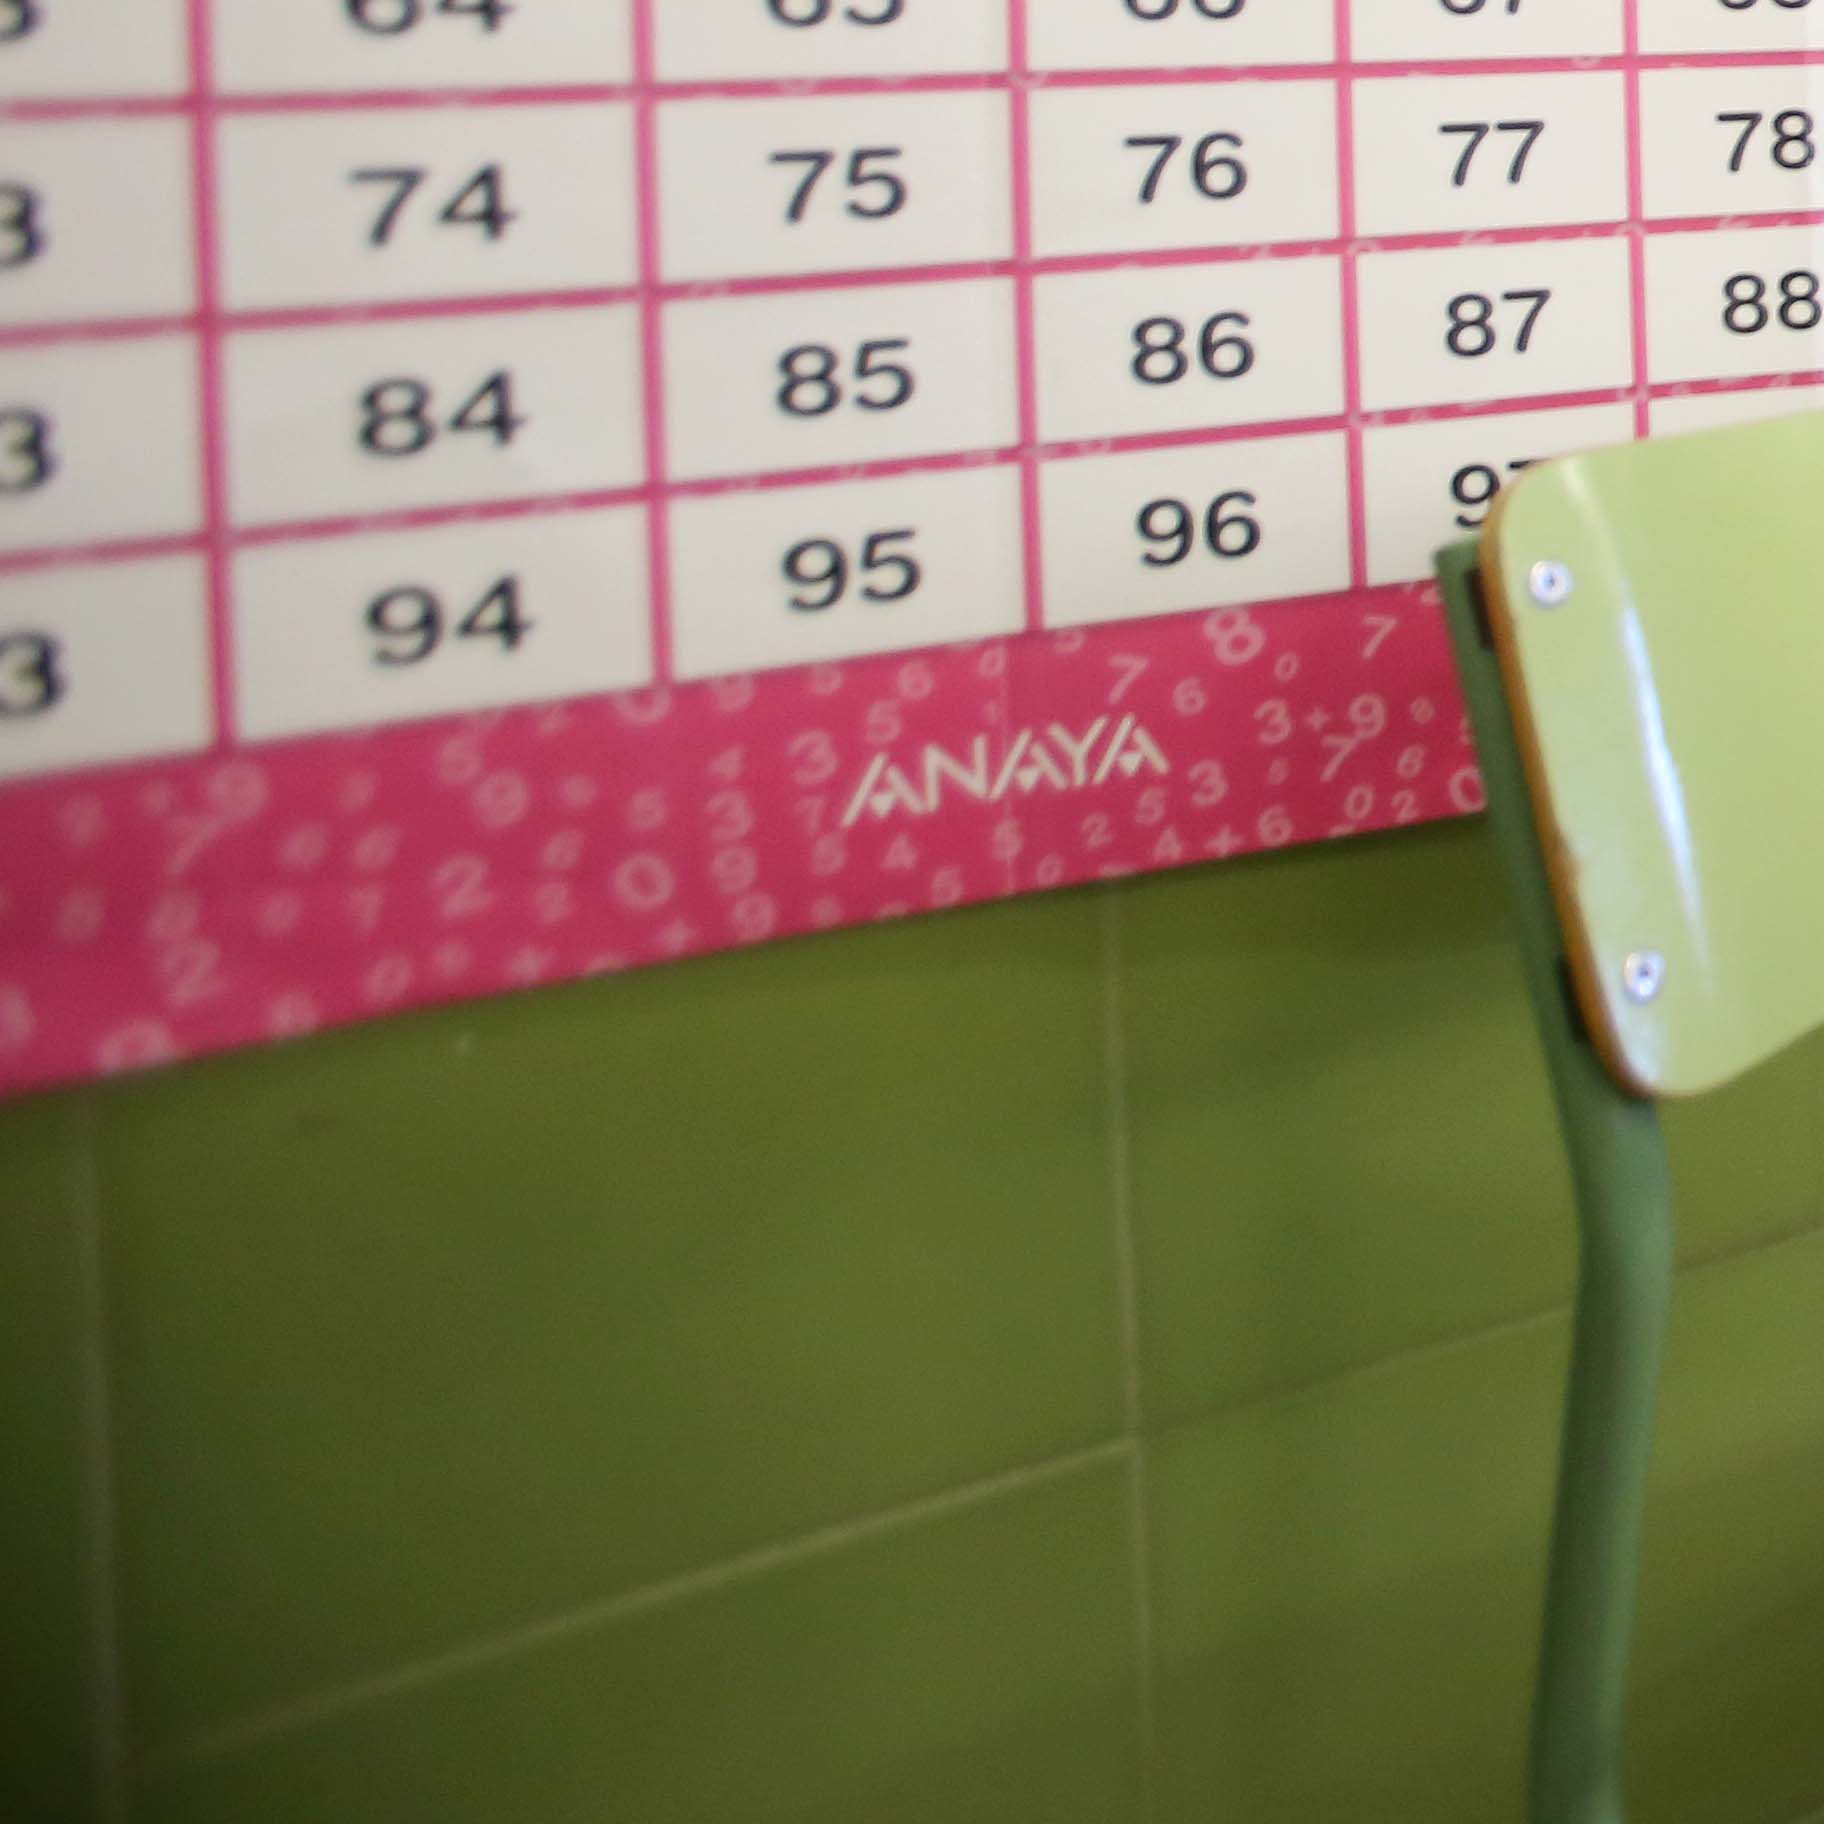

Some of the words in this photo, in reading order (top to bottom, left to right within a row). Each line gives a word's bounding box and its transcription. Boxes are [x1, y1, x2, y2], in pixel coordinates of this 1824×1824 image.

[351, 163, 516, 249] 74
[768, 145, 909, 225] 75
[1124, 130, 1249, 206] 76
[1438, 118, 1546, 188] 77
[1715, 107, 1817, 174] 78
[355, 369, 525, 460] 84
[774, 337, 917, 420] 85
[1129, 309, 1257, 388] 86
[1443, 287, 1552, 360] 87
[1720, 268, 1823, 337] 88
[363, 574, 532, 668] 94
[780, 527, 923, 615] 95
[1134, 489, 1263, 570] 96
[1449, 460, 1535, 530] 9
[842, 717, 1168, 828] ANAYA
